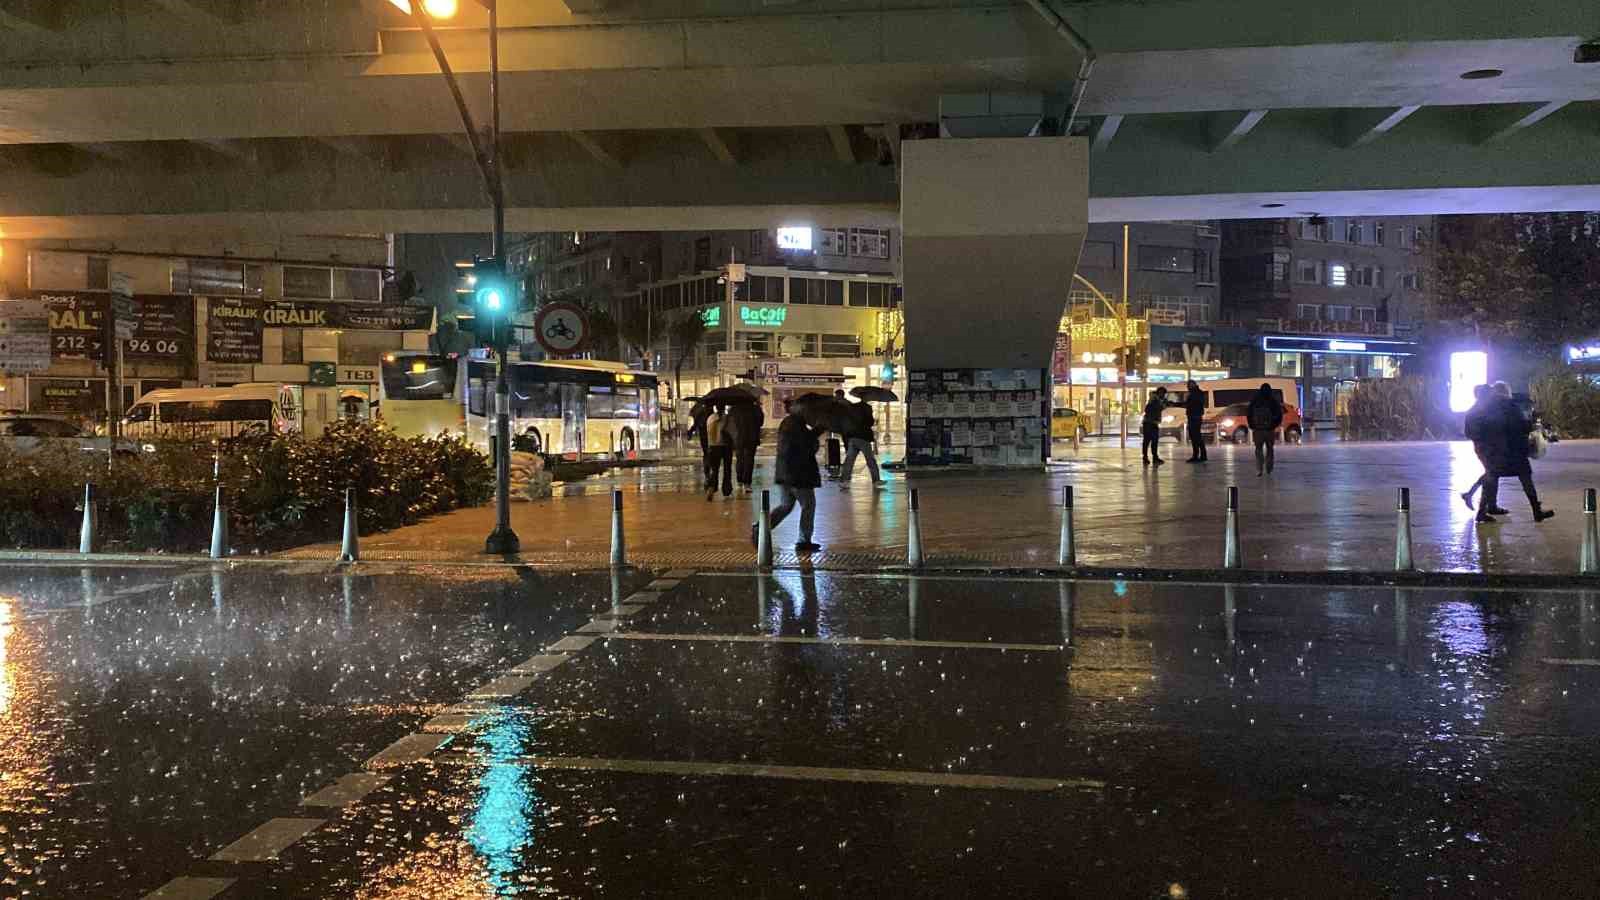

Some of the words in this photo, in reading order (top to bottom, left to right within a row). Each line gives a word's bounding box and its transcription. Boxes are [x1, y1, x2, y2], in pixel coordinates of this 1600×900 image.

[741, 306, 786, 322] BaCoff
[56, 336, 86, 350] 212
[128, 339, 150, 352] 96
[156, 341, 178, 353] 06
[343, 369, 374, 381] TEB
